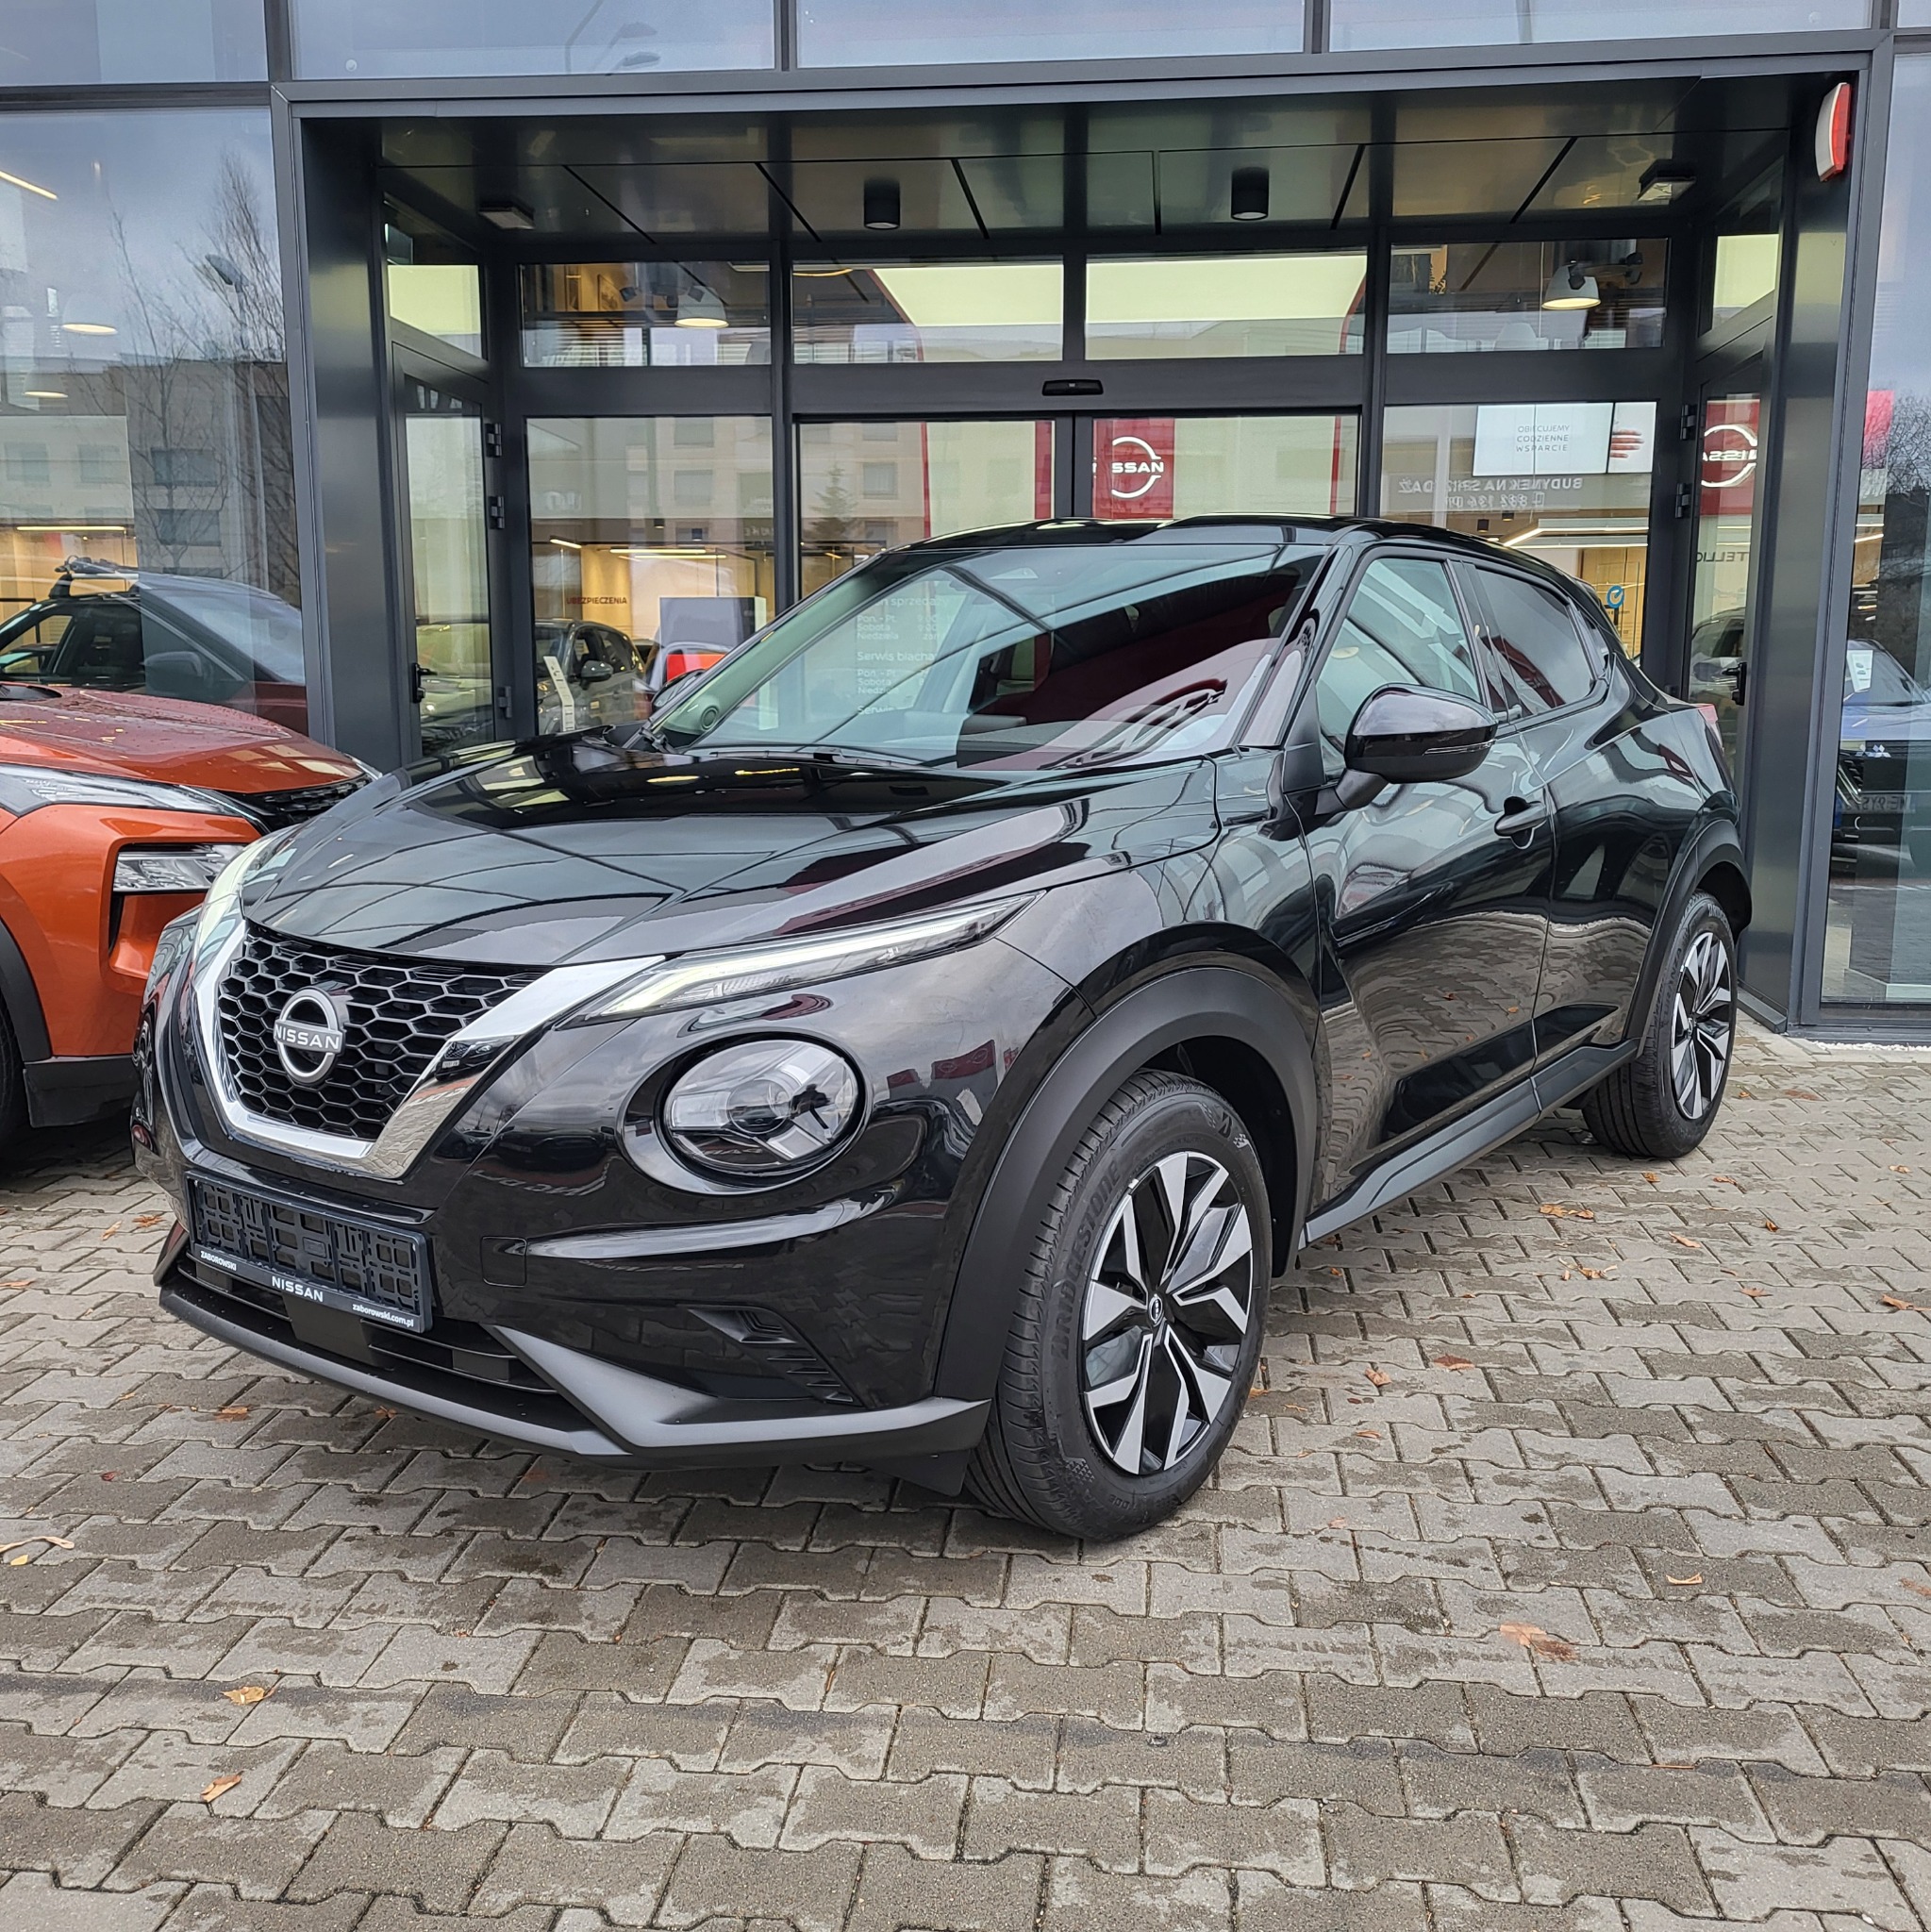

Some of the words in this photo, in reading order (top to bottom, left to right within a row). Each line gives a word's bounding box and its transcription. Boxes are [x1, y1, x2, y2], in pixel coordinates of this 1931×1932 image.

[1516, 434, 1569, 442] CODZIENNE
[1515, 443, 1569, 452] WSPARCIE
[1111, 461, 1164, 474] SSAN
[566, 596, 628, 606] UBEZPIECZENIA
[857, 651, 894, 661] Serwis
[897, 650, 936, 661] blacha
[274, 1023, 341, 1050] NISSAN
[200, 1250, 237, 1272] ZABOROWSKI
[271, 1274, 324, 1303] NISSAN
[352, 1303, 414, 1328] zaborowski.com.pl
